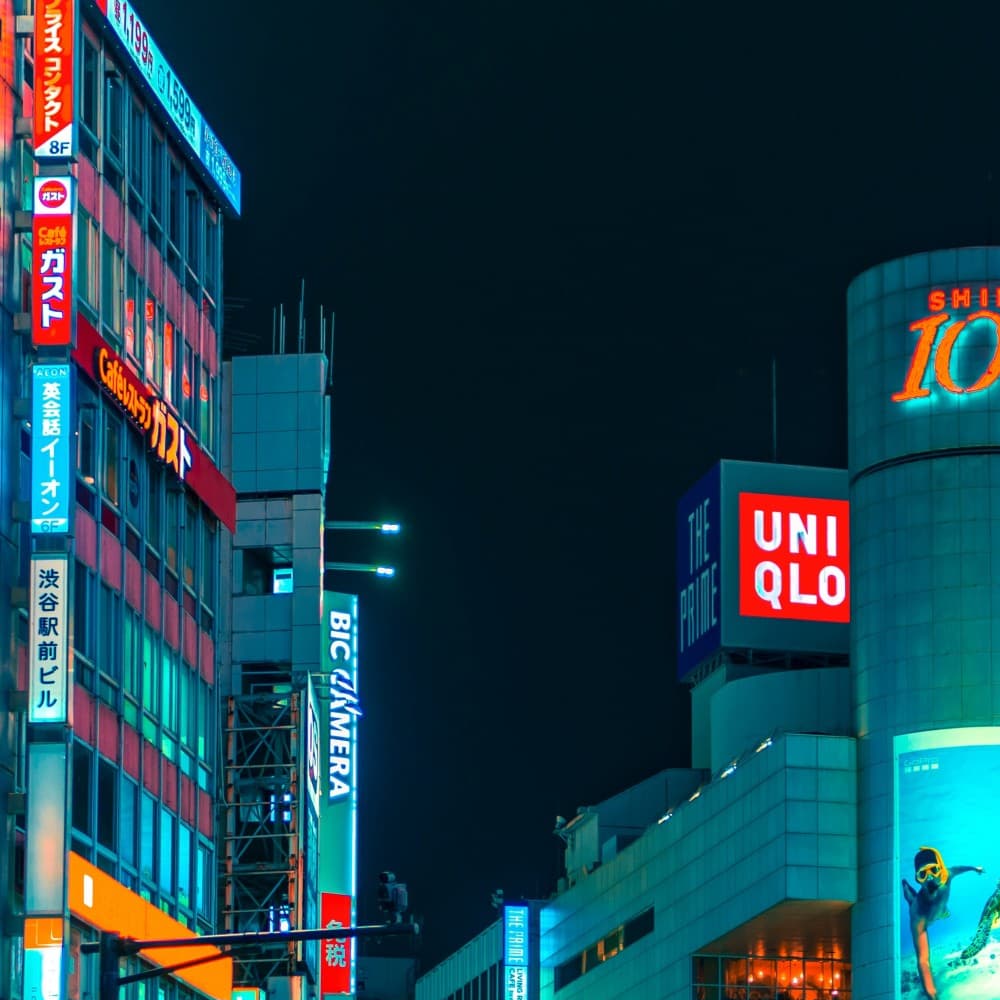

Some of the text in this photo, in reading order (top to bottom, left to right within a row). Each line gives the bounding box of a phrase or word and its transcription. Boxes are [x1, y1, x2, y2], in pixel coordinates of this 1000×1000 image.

[49, 140, 71, 155] 8F
[42, 192, 64, 201] ガスト
[41, 248, 65, 328] ガスト
[687, 498, 711, 576] THE
[753, 509, 838, 557] UNI
[680, 562, 718, 653] PRIME
[753, 560, 847, 610] QLO
[38, 569, 60, 709] 渋谷駅前ビル
[329, 610, 351, 660] BIC
